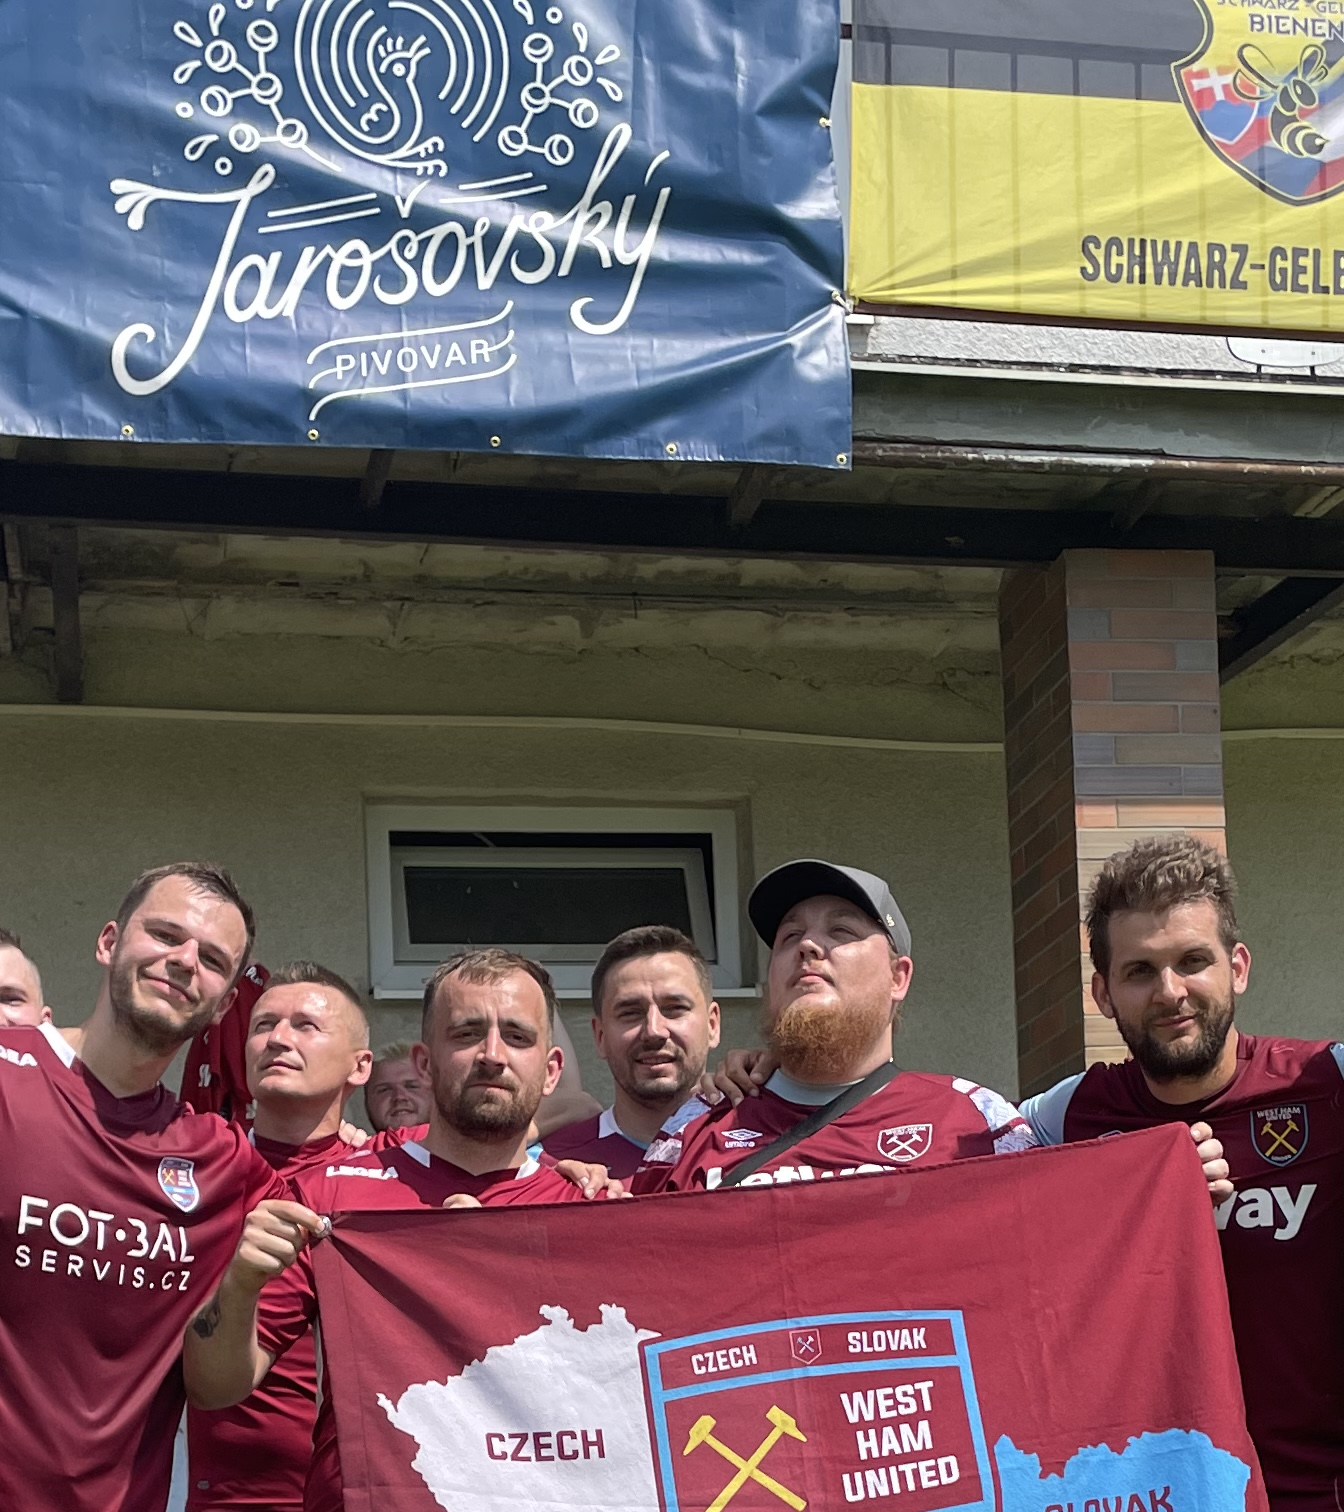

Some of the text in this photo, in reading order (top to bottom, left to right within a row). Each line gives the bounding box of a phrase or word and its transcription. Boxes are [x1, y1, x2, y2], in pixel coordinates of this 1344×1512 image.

[335, 339, 491, 380] PIVOVAR
[14, 1245, 191, 1292] SERVIS.CZ
[690, 1327, 927, 1376] CZECH SLOVAK
[839, 1380, 934, 1424] WEST
[485, 1428, 606, 1462] CZECH
[855, 1420, 934, 1461] HAM
[841, 1455, 960, 1503] UNITED
